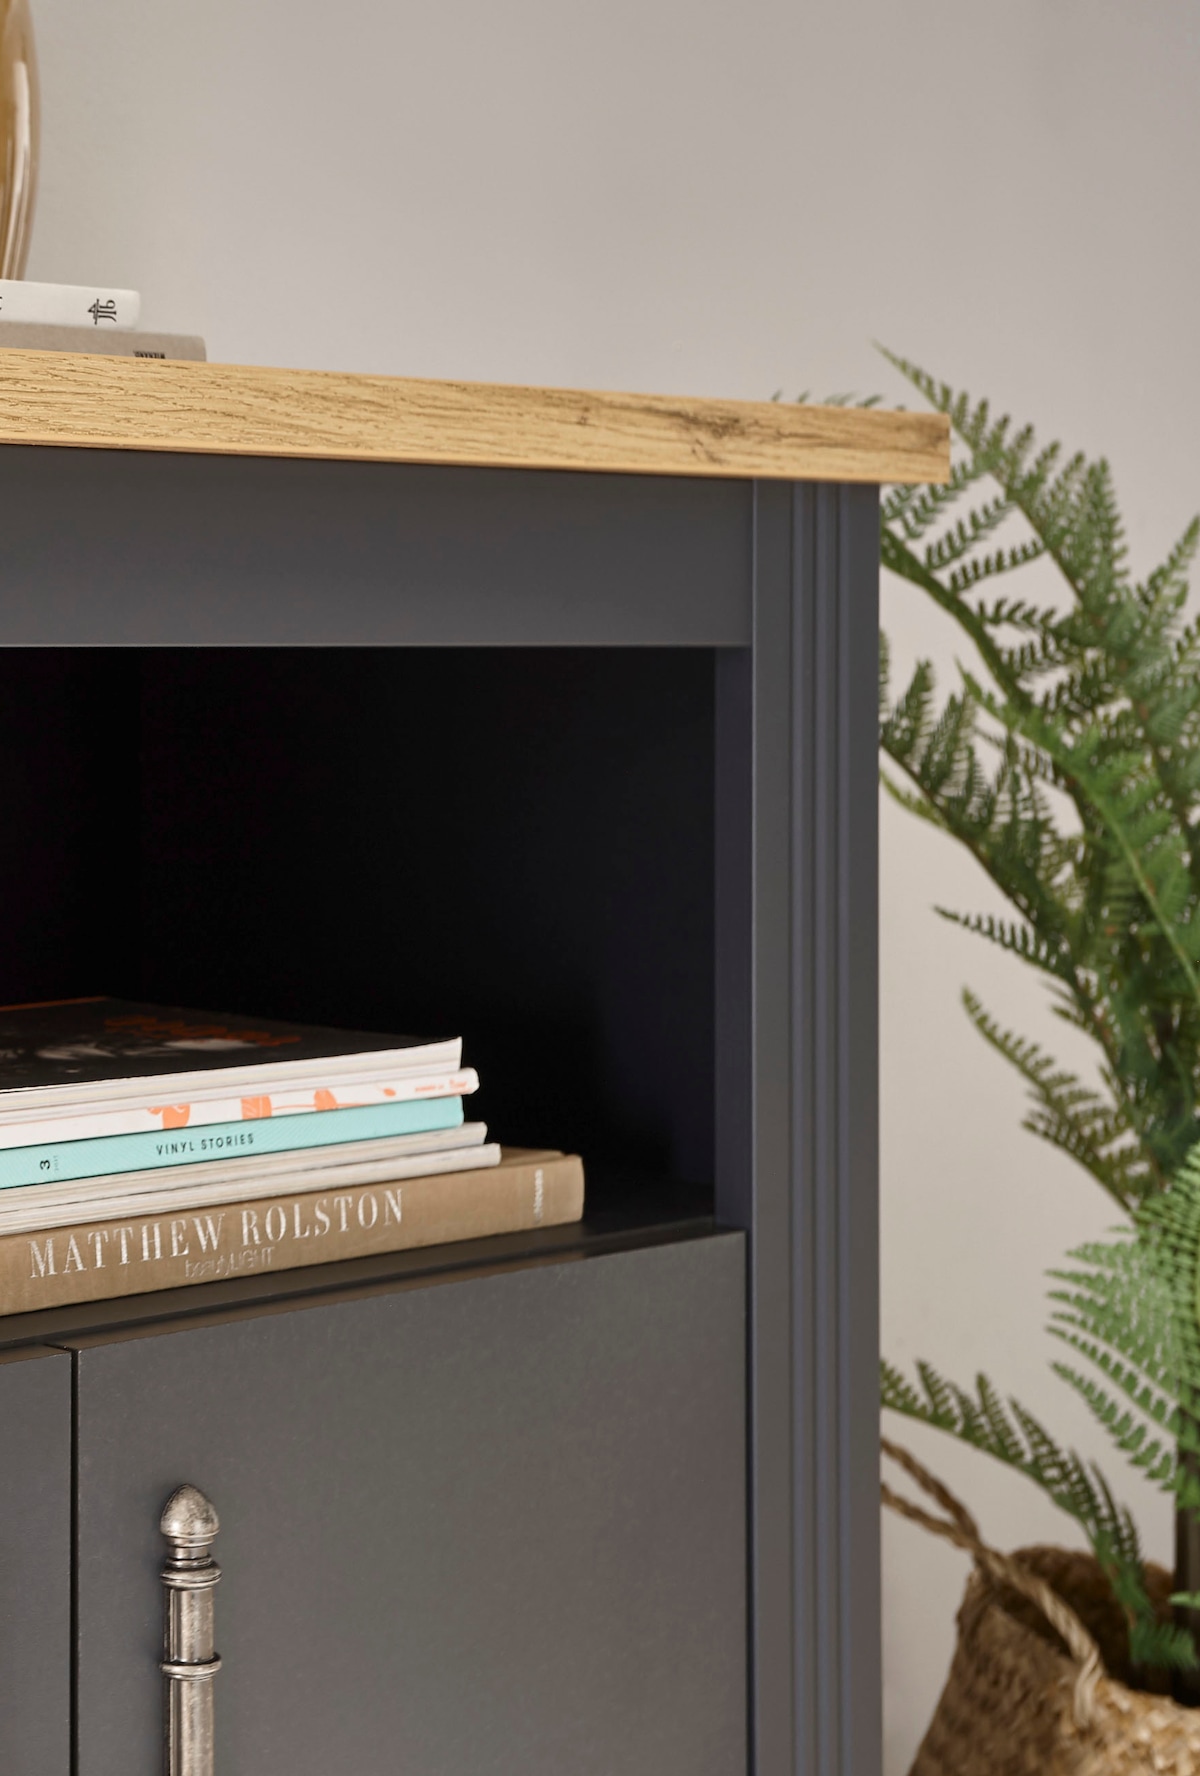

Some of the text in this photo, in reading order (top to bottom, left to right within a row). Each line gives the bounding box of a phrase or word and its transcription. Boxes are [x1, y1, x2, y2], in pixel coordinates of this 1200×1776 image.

[155, 1132, 255, 1156] VINYL STORIES
[27, 1188, 403, 1279] MATTHEW ROLSTON
